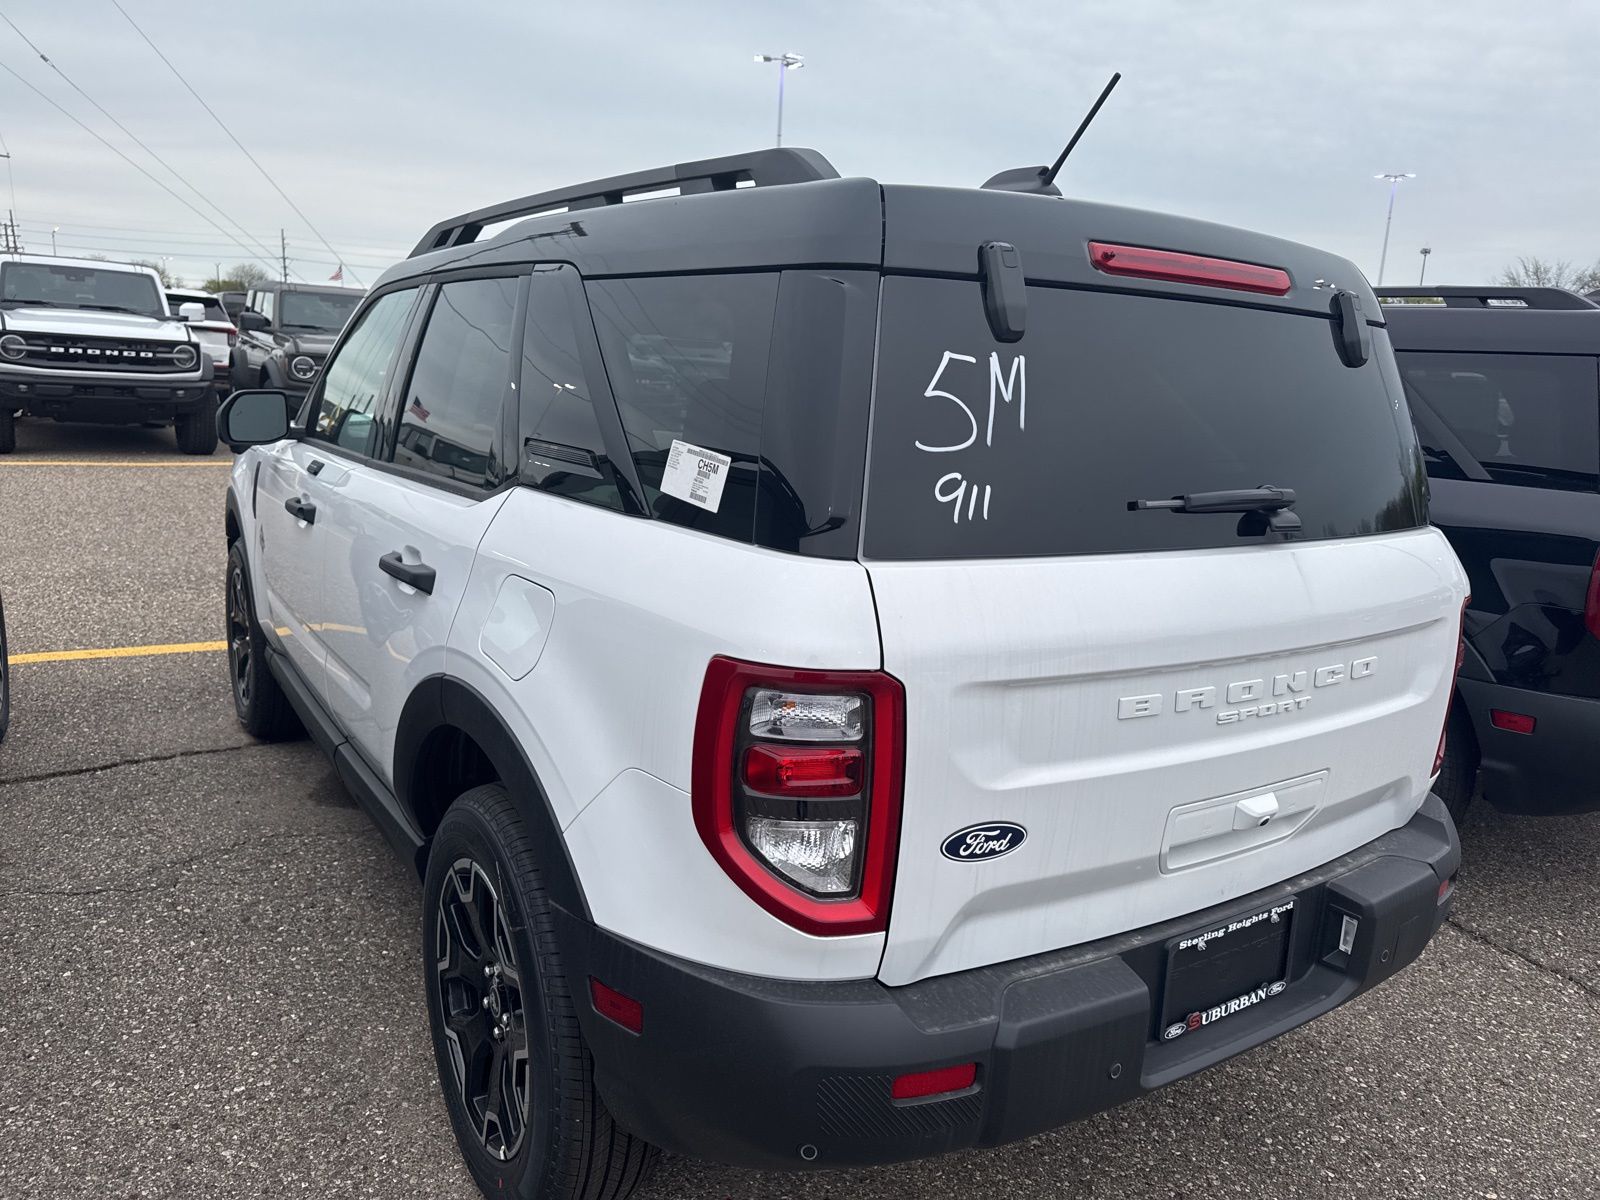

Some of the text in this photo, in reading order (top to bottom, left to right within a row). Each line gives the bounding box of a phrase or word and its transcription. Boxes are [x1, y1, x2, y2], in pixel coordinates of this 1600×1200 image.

[50, 346, 154, 358] BRONCO
[915, 350, 1026, 453] 5M
[697, 458, 720, 475] CH5M
[934, 472, 992, 524] 911
[1117, 656, 1379, 720] BRONCO
[1216, 696, 1312, 725] SPORT
[958, 828, 1014, 857] Ford
[1179, 901, 1294, 950] Sterling Heights Ford
[1187, 987, 1267, 1031] SUBURBAN
